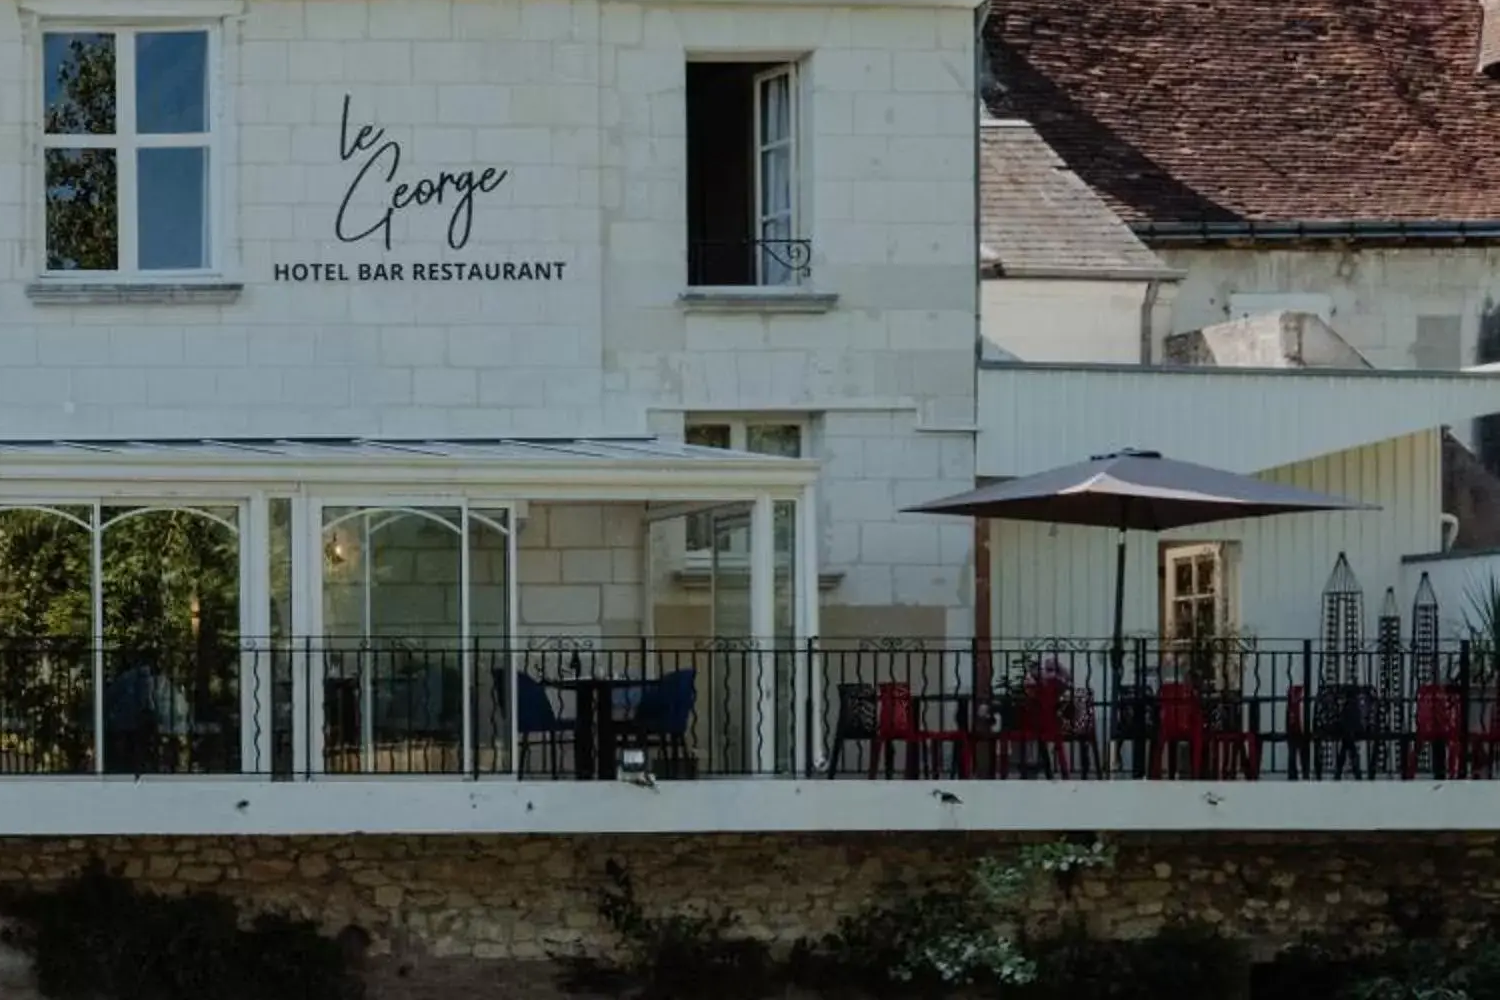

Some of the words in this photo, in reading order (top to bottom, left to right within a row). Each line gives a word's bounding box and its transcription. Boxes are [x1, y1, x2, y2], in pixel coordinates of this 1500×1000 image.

[336, 141, 508, 251] George
[274, 263, 350, 282] HOTEL
[358, 263, 404, 281] BAR
[412, 262, 566, 281] RESTAURANT
